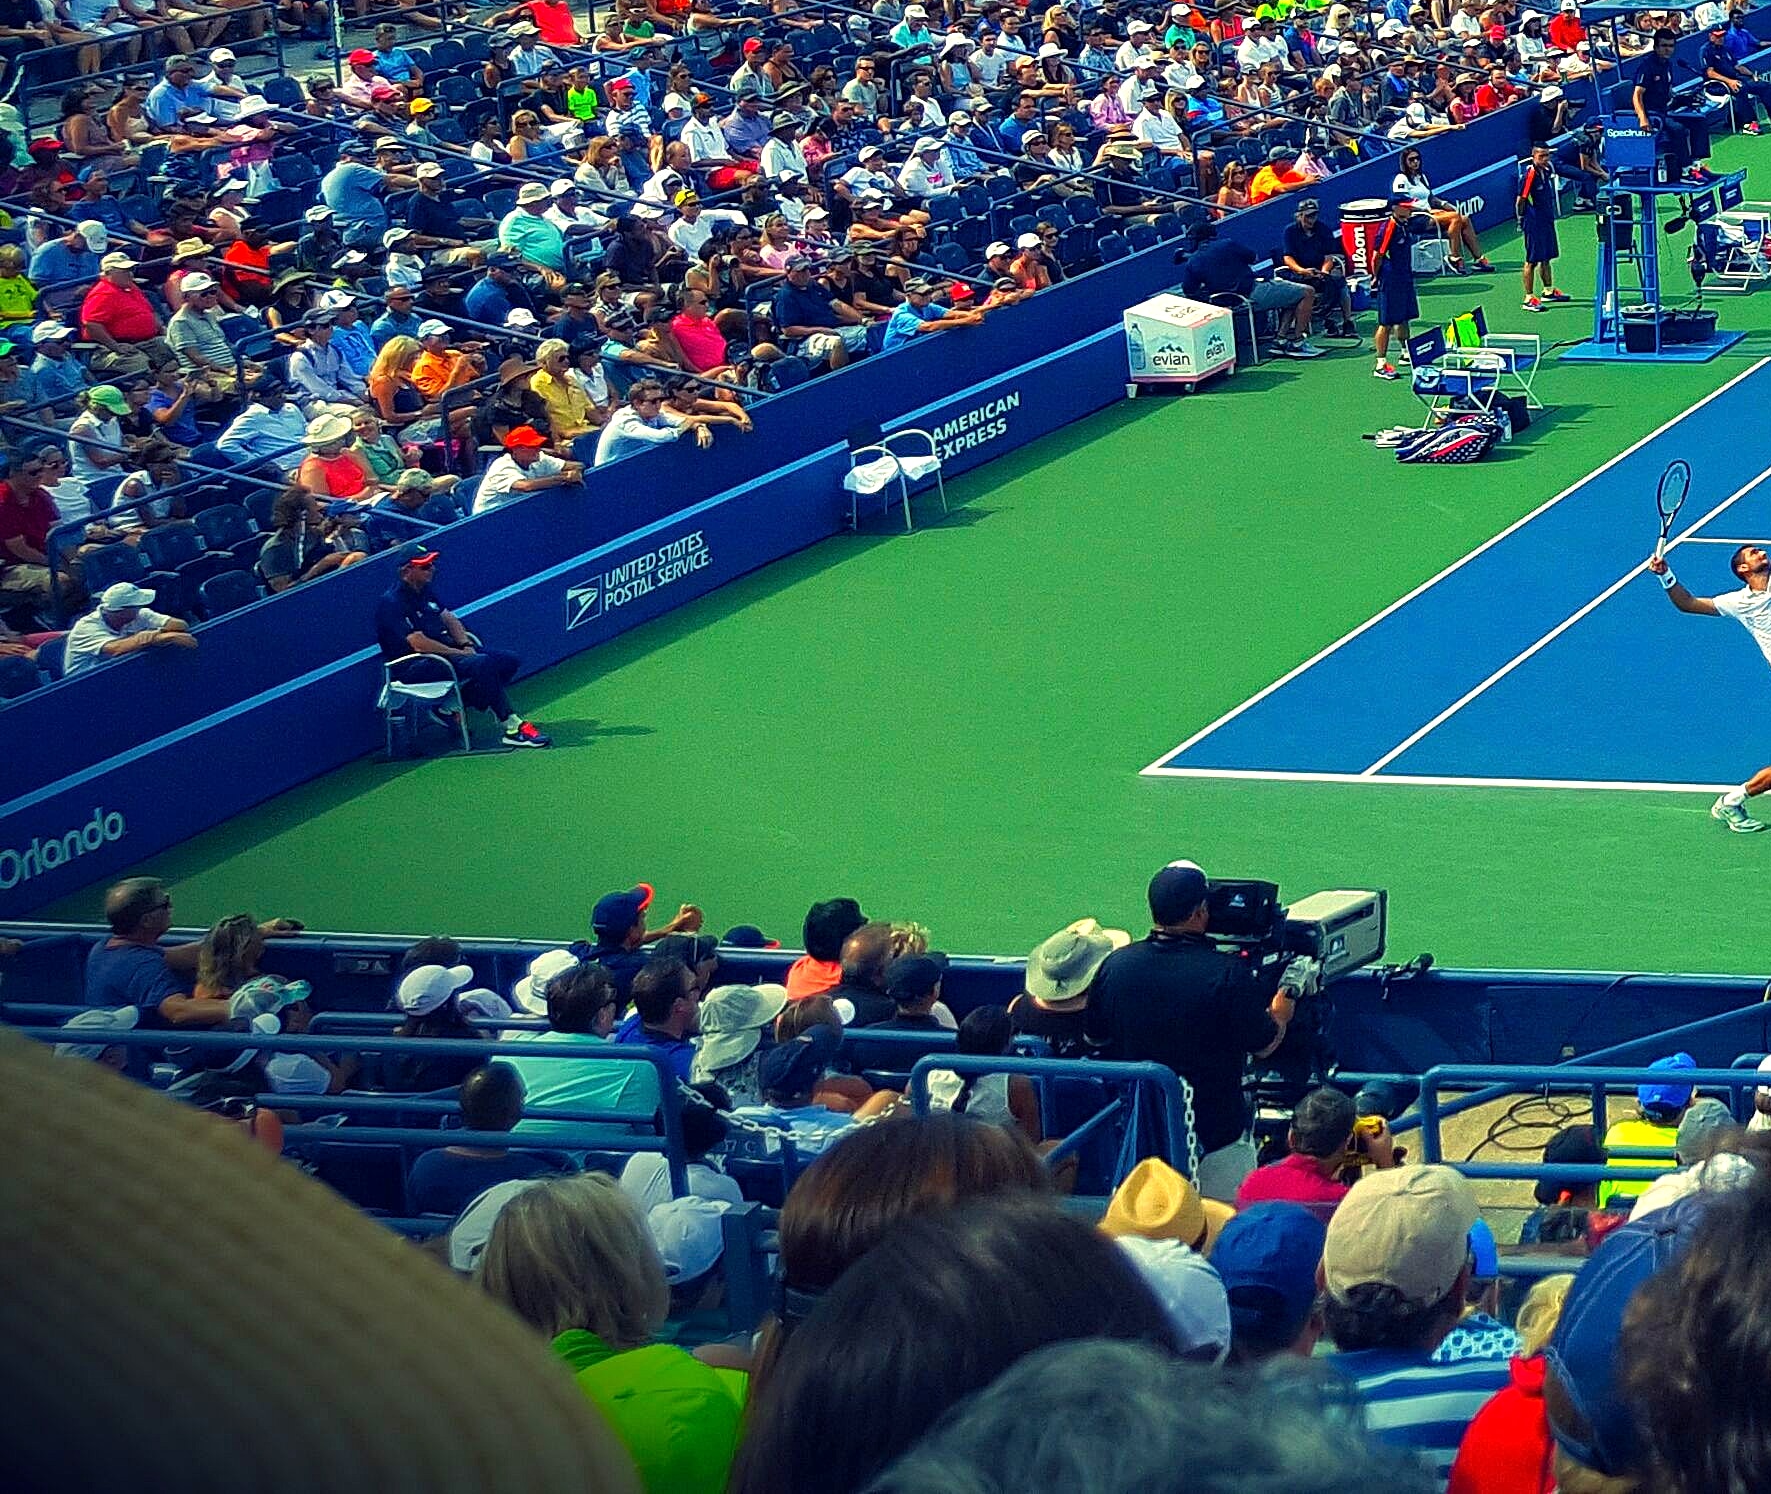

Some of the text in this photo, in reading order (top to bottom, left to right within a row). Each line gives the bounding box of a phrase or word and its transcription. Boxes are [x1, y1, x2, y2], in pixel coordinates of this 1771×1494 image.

[1153, 354, 1190, 366] evian
[933, 391, 1020, 441] AMERICAN
[605, 530, 703, 589] UNITED STATES
[605, 546, 711, 611] POSTAL SERVICE
